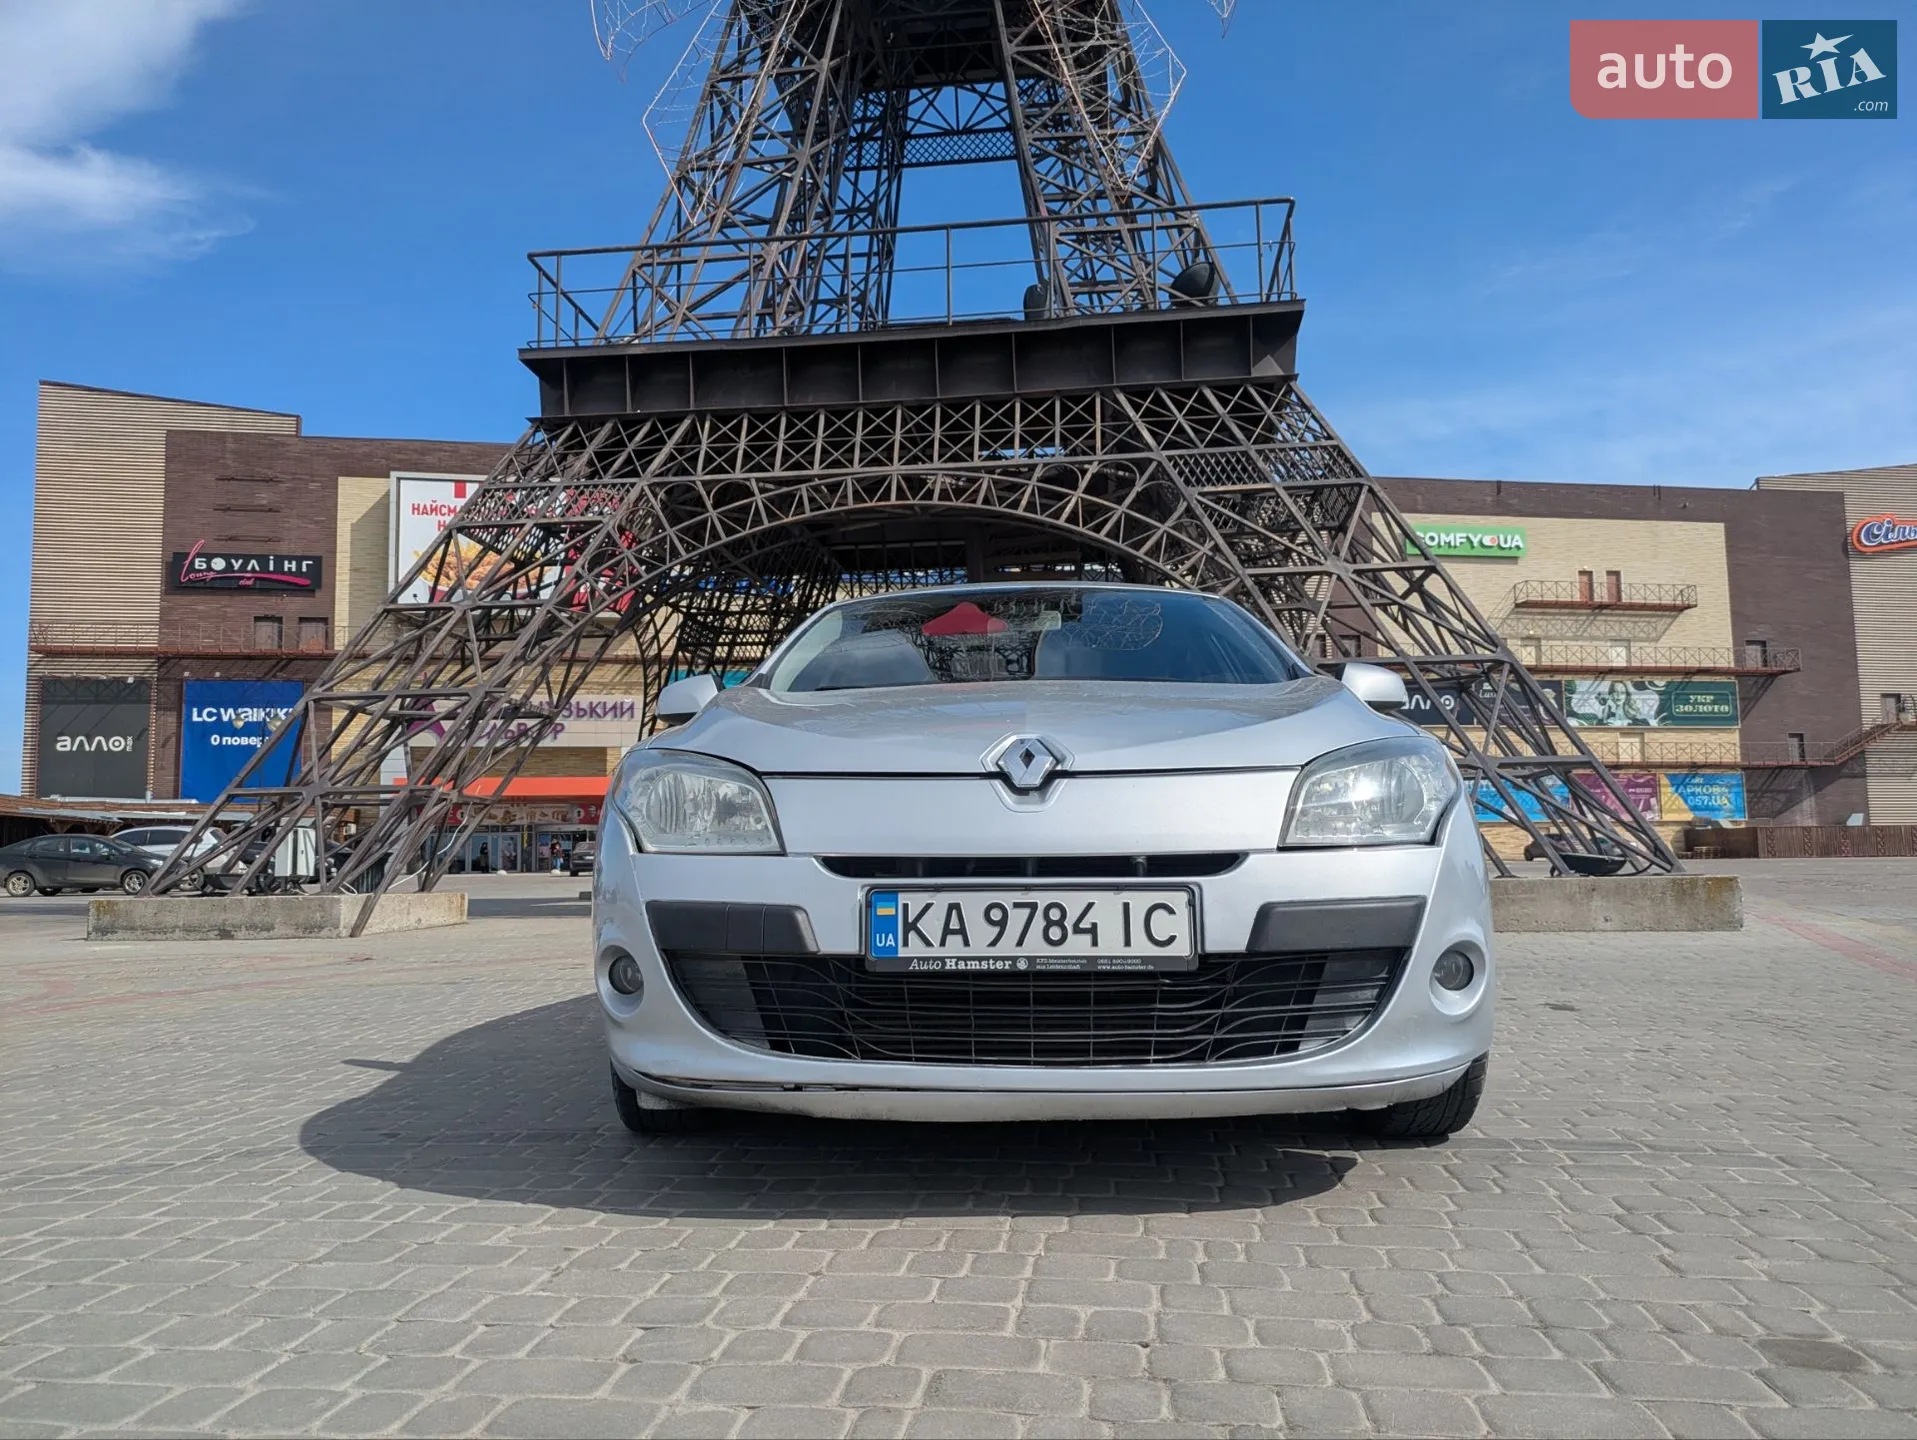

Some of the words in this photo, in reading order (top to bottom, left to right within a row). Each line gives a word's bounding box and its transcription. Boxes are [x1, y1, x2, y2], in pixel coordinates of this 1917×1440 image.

[411, 499, 458, 517] НАЙСМ
[192, 707, 218, 722] LC
[902, 902, 971, 948] KA
[984, 901, 1099, 948] 9784
[1122, 901, 1178, 948] IC
[876, 933, 896, 947] UA
[909, 959, 942, 970] Auto
[945, 959, 1012, 970] Hamster
